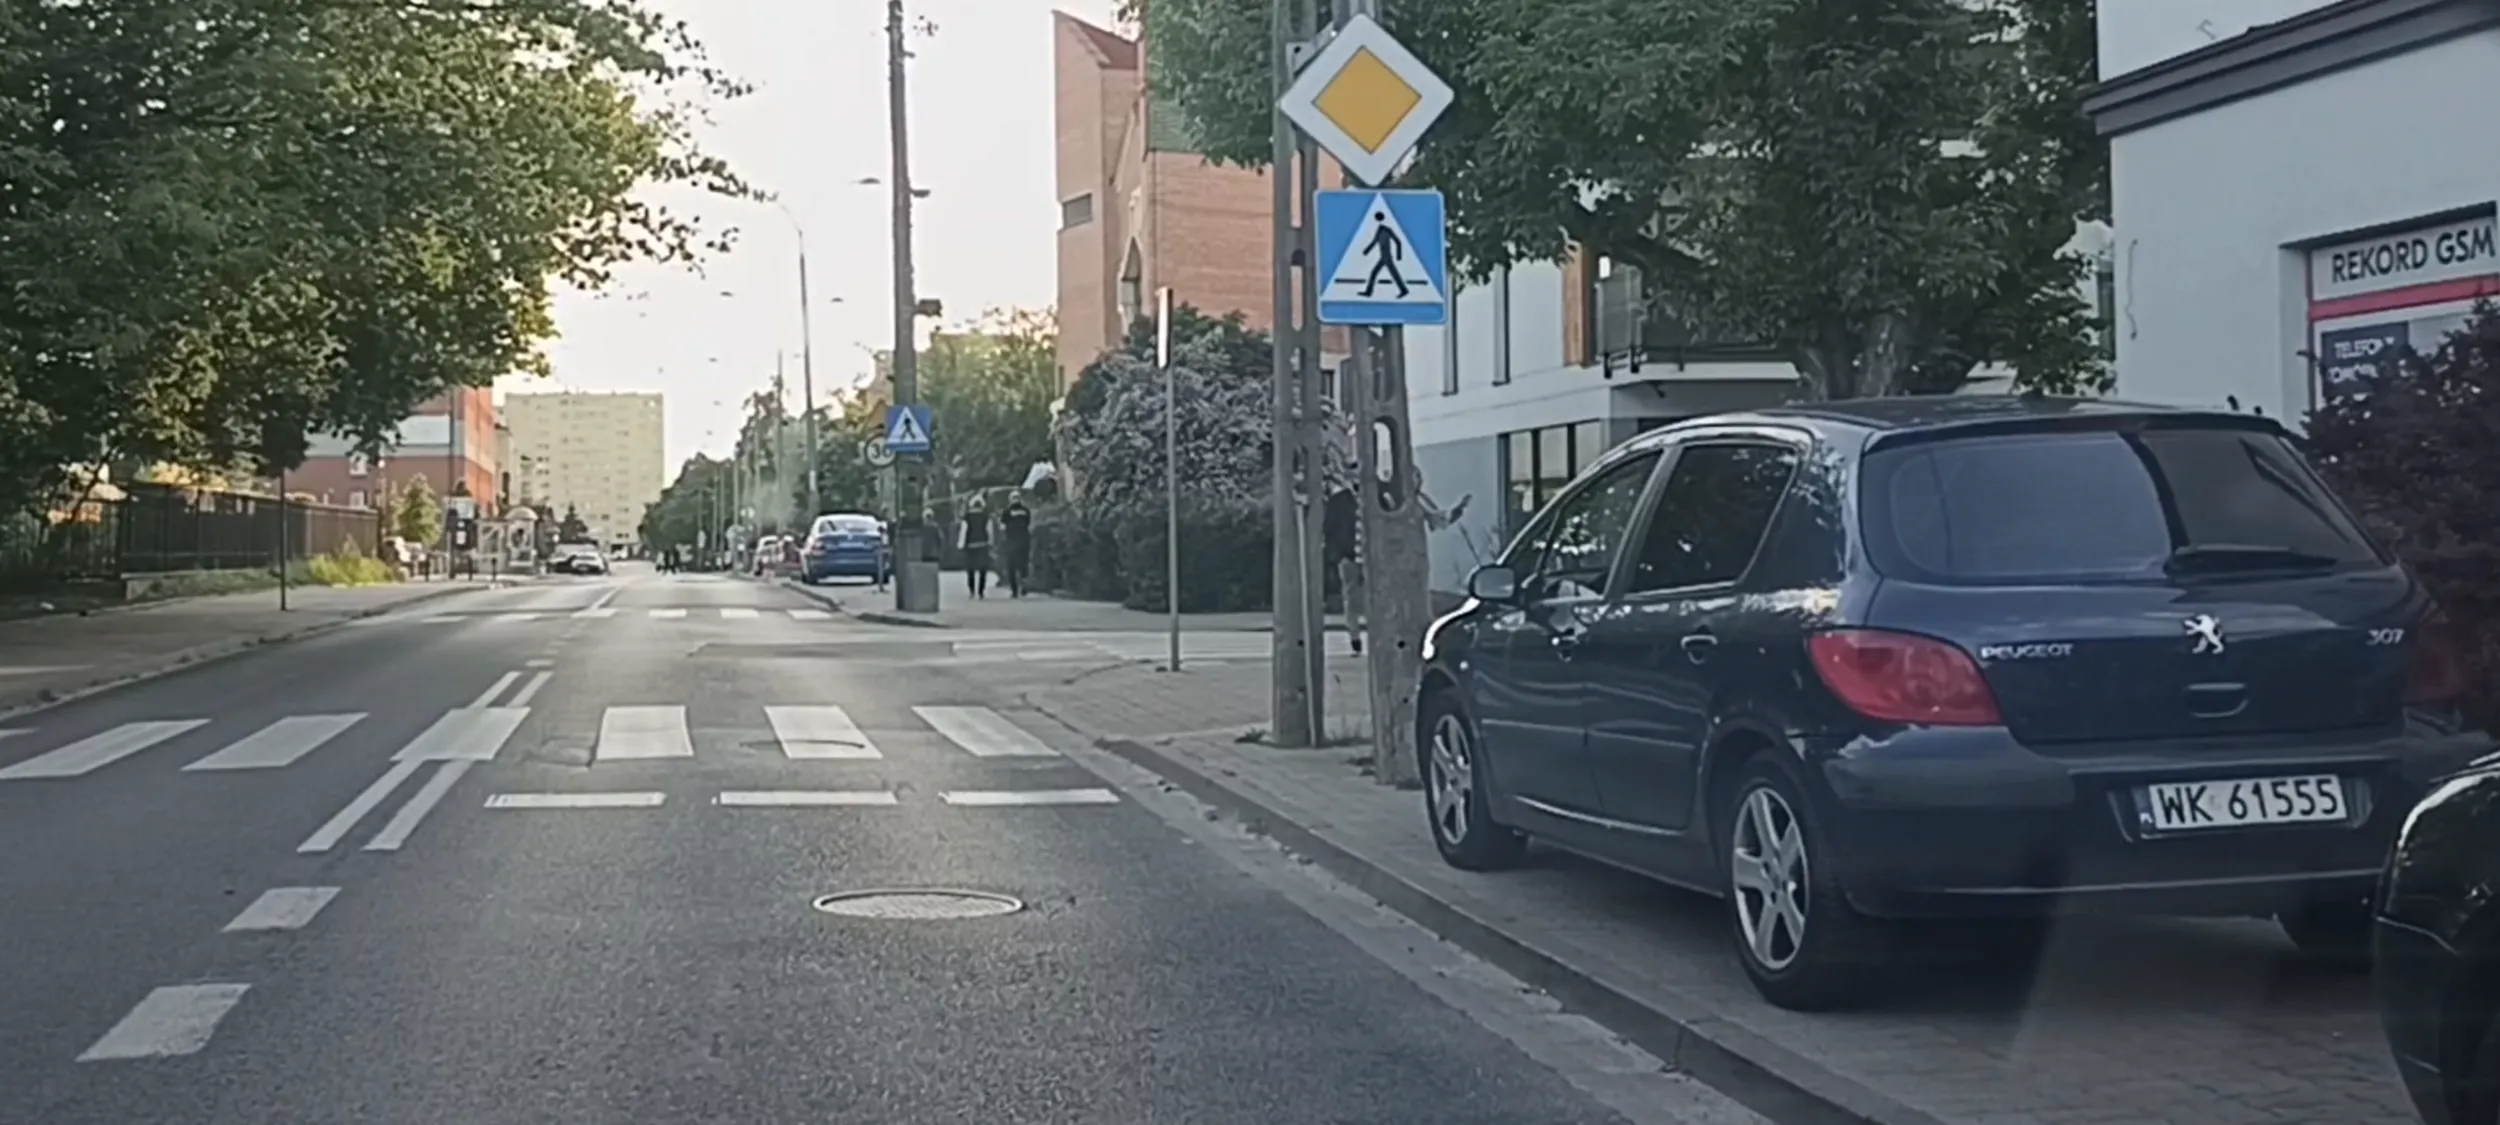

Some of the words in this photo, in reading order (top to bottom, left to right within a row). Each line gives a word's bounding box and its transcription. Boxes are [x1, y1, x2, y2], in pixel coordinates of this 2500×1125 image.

[2332, 238, 2428, 283] REKORD
[2436, 225, 2496, 265] GSM
[2334, 337, 2395, 358] TELEFO
[2365, 628, 2405, 646] 307
[1981, 643, 2074, 659] PEUGEOT
[2157, 784, 2214, 825] WK
[2227, 777, 2338, 821] 61555
